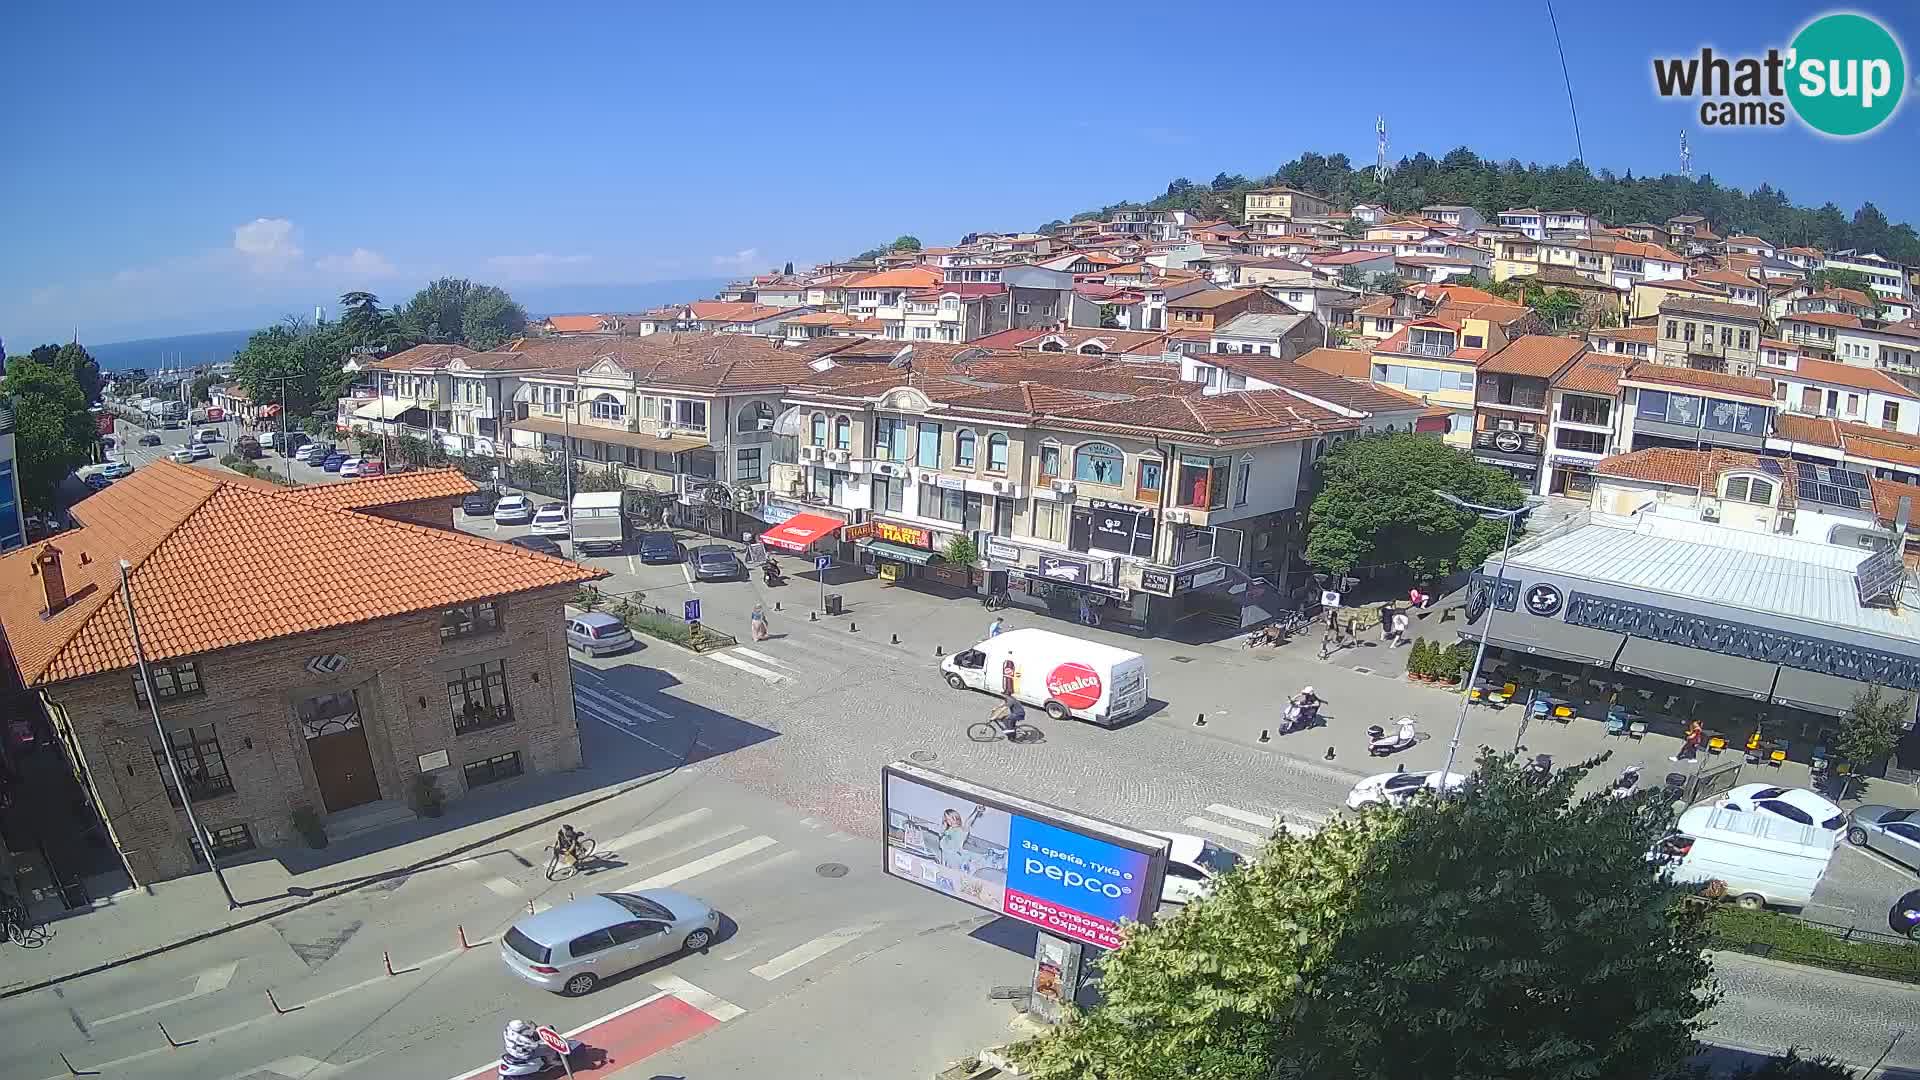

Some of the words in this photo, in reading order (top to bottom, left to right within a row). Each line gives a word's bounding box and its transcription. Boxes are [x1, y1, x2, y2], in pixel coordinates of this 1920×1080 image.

[883, 529, 915, 545] HARI
[819, 558, 826, 569] P
[1050, 676, 1098, 696] Sinalco
[1021, 840, 1039, 853] За
[1089, 861, 1121, 877] тука
[1123, 872, 1133, 880] е
[1009, 902, 1047, 920] 02.07
[541, 1030, 567, 1049] STOP
